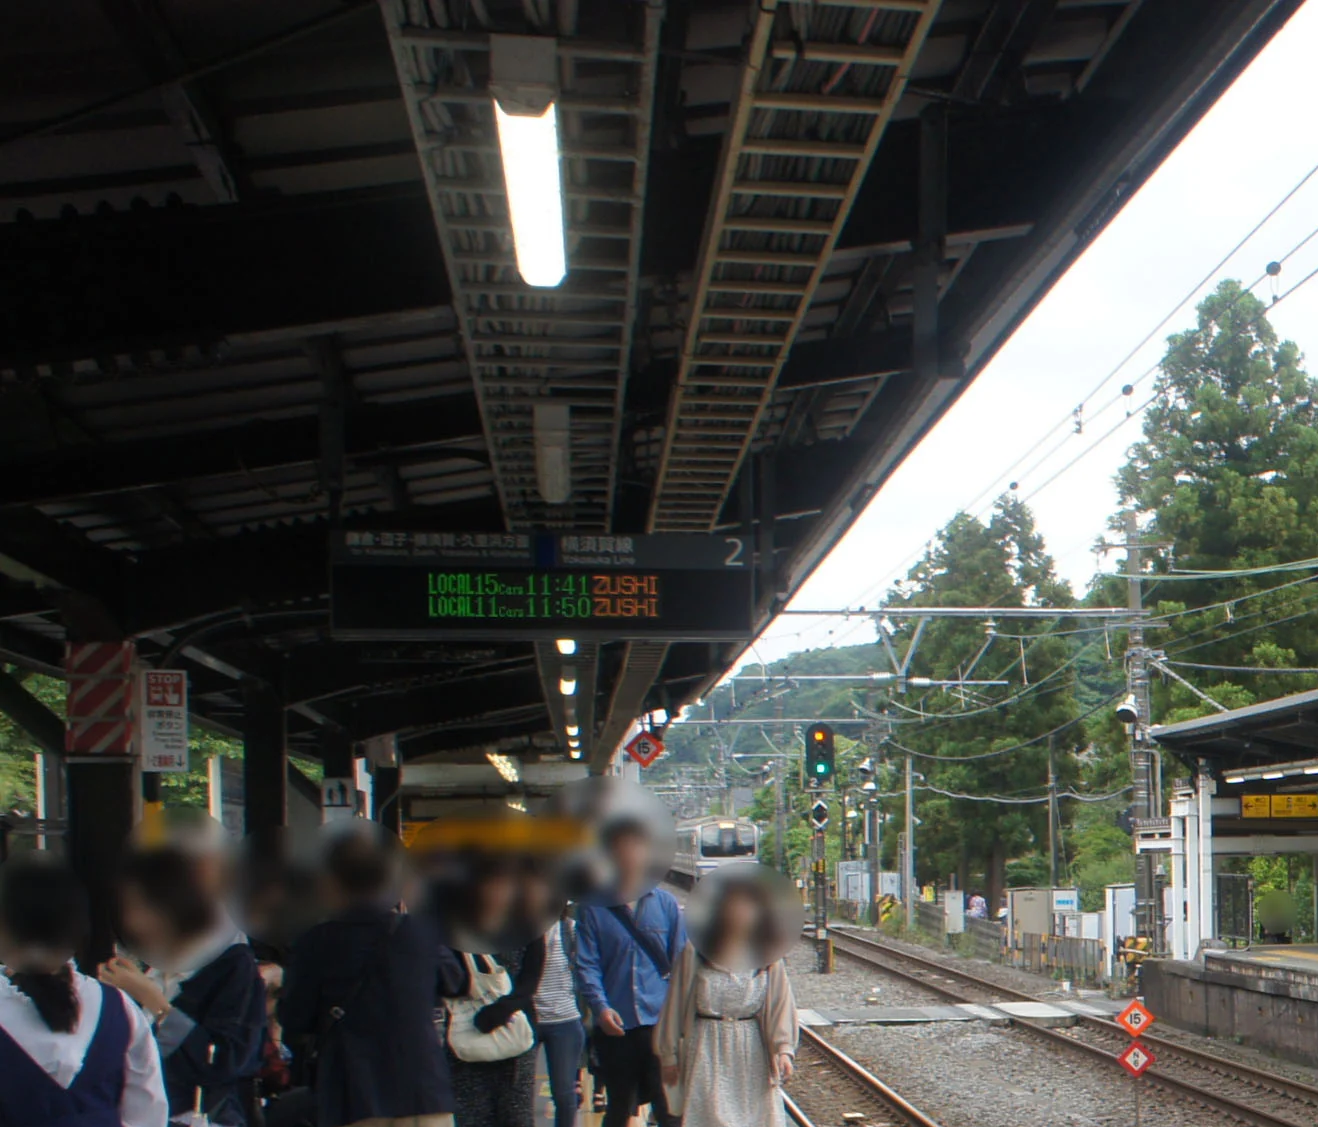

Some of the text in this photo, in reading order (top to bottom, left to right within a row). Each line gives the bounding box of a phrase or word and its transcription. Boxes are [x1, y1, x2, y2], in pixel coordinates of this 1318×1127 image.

[724, 538, 744, 566] 2
[428, 574, 659, 595] LOCAL 15 Cars 11:41 ZUSHI
[428, 597, 659, 618] LOCAL 11 Cars 11:50 ZUSHI
[148, 674, 181, 684] STOP
[638, 742, 650, 754] 15
[1129, 1013, 1141, 1024] 15
